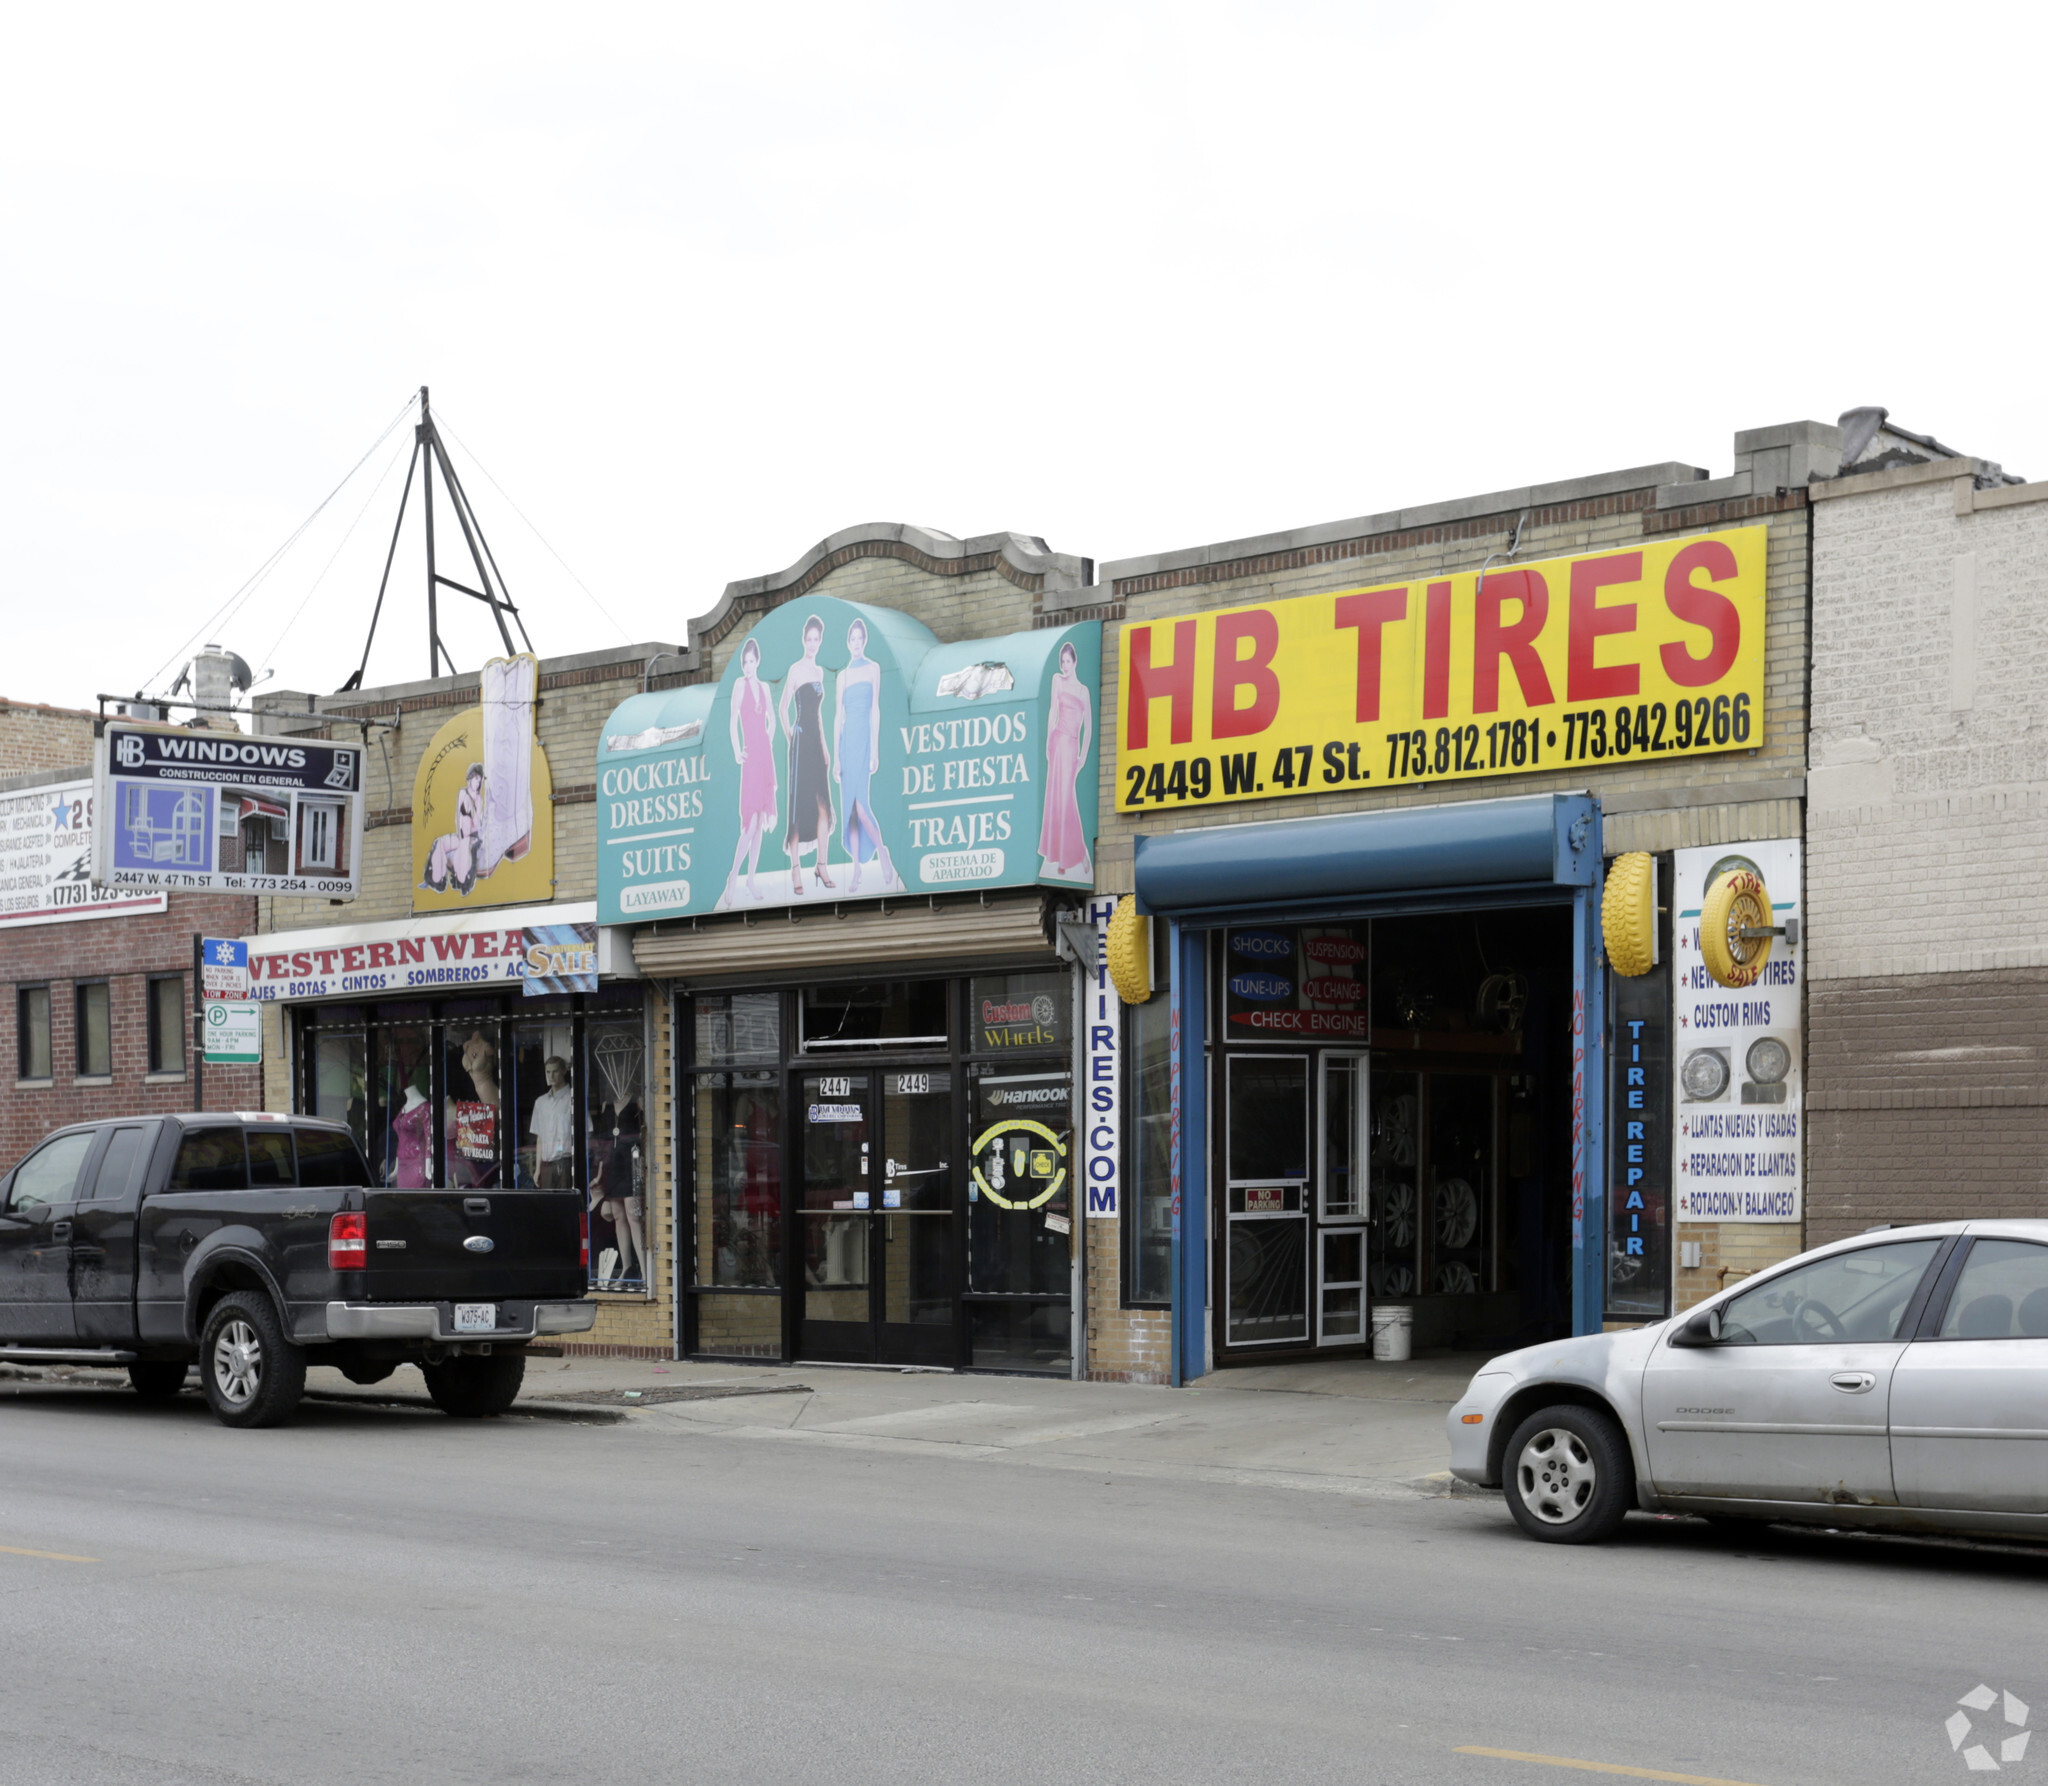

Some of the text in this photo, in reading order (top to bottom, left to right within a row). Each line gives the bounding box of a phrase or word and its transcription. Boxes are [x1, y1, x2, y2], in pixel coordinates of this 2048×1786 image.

[1127, 540, 1741, 751] HB TIRES
[900, 711, 1027, 755] VESTIDOS
[1386, 692, 1751, 779] 773.812.1781 773.842.9266
[157, 738, 307, 768] WINDOWS
[159, 767, 306, 787] CONSTRUCCION EN GENERAL
[602, 754, 711, 797] COCKTAIL
[901, 753, 1030, 795] DE FIESTA
[1125, 740, 1370, 806] 2449 W. 47 St.
[610, 789, 704, 830] DRESSES
[908, 810, 1012, 851] TRAJES
[622, 843, 691, 878] SUITS
[929, 852, 996, 869] SISTEMA DE
[114, 872, 144, 885] 2447
[147, 874, 161, 885] W.
[164, 875, 178, 886] 47
[182, 875, 195, 886] Th
[198, 875, 212, 887] ST
[224, 876, 246, 888] Tel:
[250, 877, 276, 889] 773
[280, 878, 307, 891] 254
[317, 880, 353, 892] 0099
[932, 866, 993, 881] APARTADO
[1727, 872, 1761, 895] TIRE
[54, 884, 87, 906] (773)
[626, 887, 686, 907] LAYAWAY
[1233, 936, 1290, 955] SHOCKS
[1306, 942, 1365, 960] SUSPENSION
[528, 944, 594, 978] SALE
[1764, 960, 1796, 986] TIRES
[247, 985, 276, 1000] AJES
[289, 980, 327, 996] BOTAS
[342, 973, 386, 991] CINTOS
[407, 964, 489, 986] SOMBREROS
[1233, 979, 1290, 996] TUNE-UPS
[1727, 965, 1758, 987] SALE
[206, 990, 243, 999] TOW ZONE
[1307, 981, 1360, 1000] OIL CHANGE
[983, 1000, 1031, 1024] Custom
[1250, 1011, 1366, 1030] CHECK ENGINE
[1694, 1001, 1771, 1028] CUSTOM RIMS
[821, 1078, 849, 1095] 2447
[899, 1075, 929, 1093] 2449
[1170, 1008, 1180, 1216] NO PARKING
[1572, 989, 1583, 1222] NO PARKING
[1691, 1113, 1797, 1138] LLANTAS NUEVAS Y USADAS
[1626, 1020, 1645, 1256] TIRE REPAIR
[1690, 1152, 1796, 1177] REPARACION DE LLANTAS
[1248, 1200, 1280, 1210] PARKING
[1258, 1190, 1271, 1200] NO
[1690, 1192, 1794, 1216] ROTACION Y BALANCEO
[1676, 1407, 1736, 1415] DODGE
